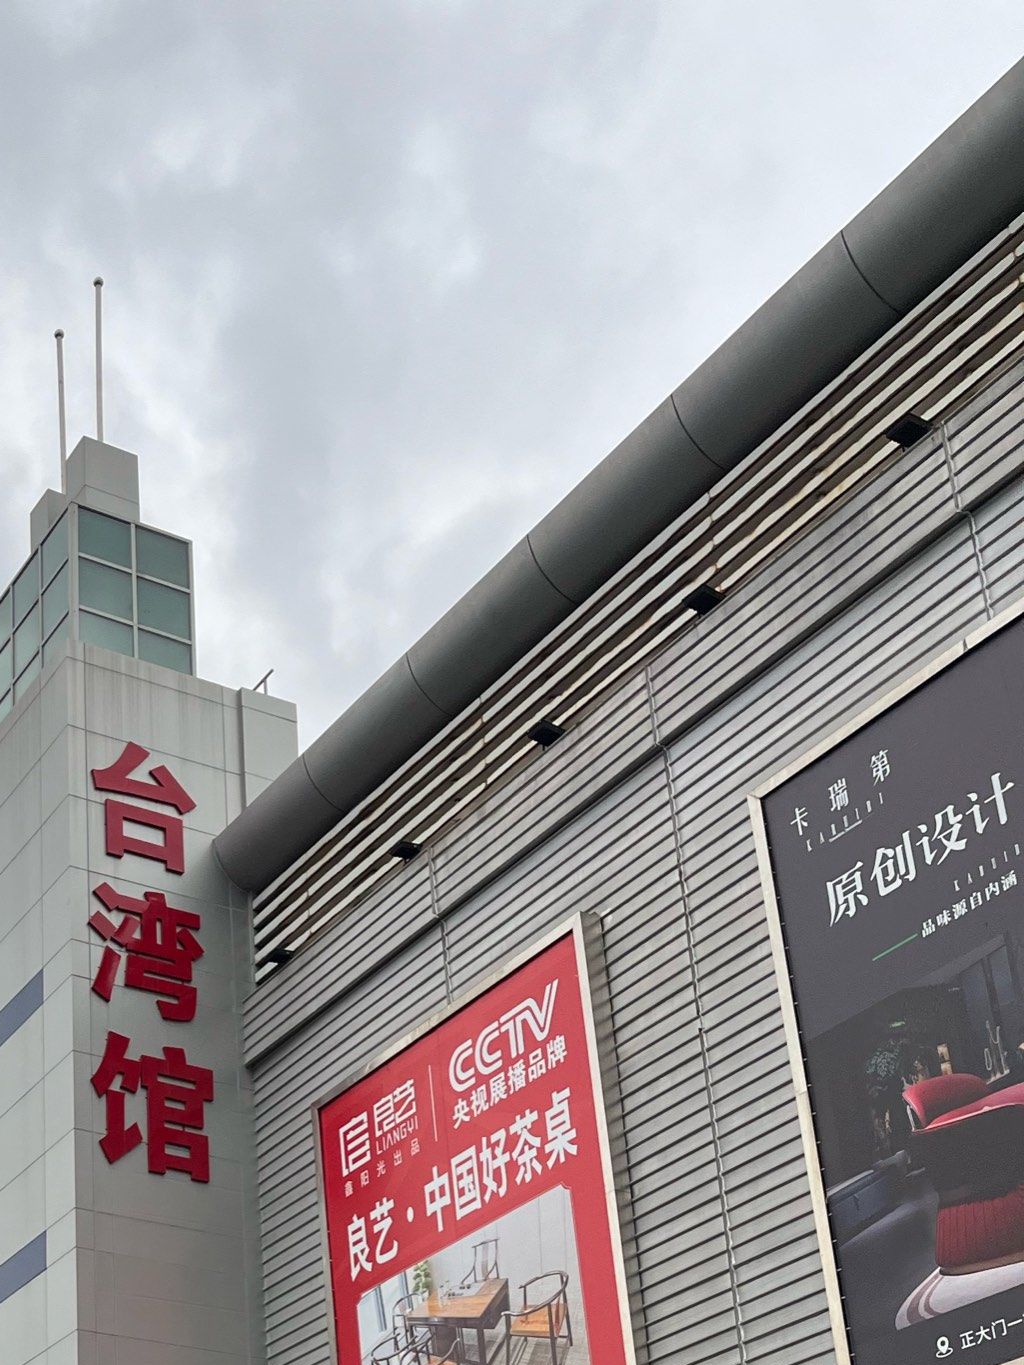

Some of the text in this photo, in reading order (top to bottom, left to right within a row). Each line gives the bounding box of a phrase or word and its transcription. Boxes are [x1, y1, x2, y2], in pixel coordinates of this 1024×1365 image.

[790, 749, 890, 836] 卡瑞第
[826, 772, 1015, 927] 原创设计
[921, 869, 1018, 938] 品味源自内涵
[87, 740, 214, 1184] 台湾馆
[448, 978, 559, 1093] CCTV
[452, 1034, 568, 1130] 央视展播品牌
[376, 1116, 419, 1155] LIANGYI
[959, 1313, 1024, 1350] 正大门一
